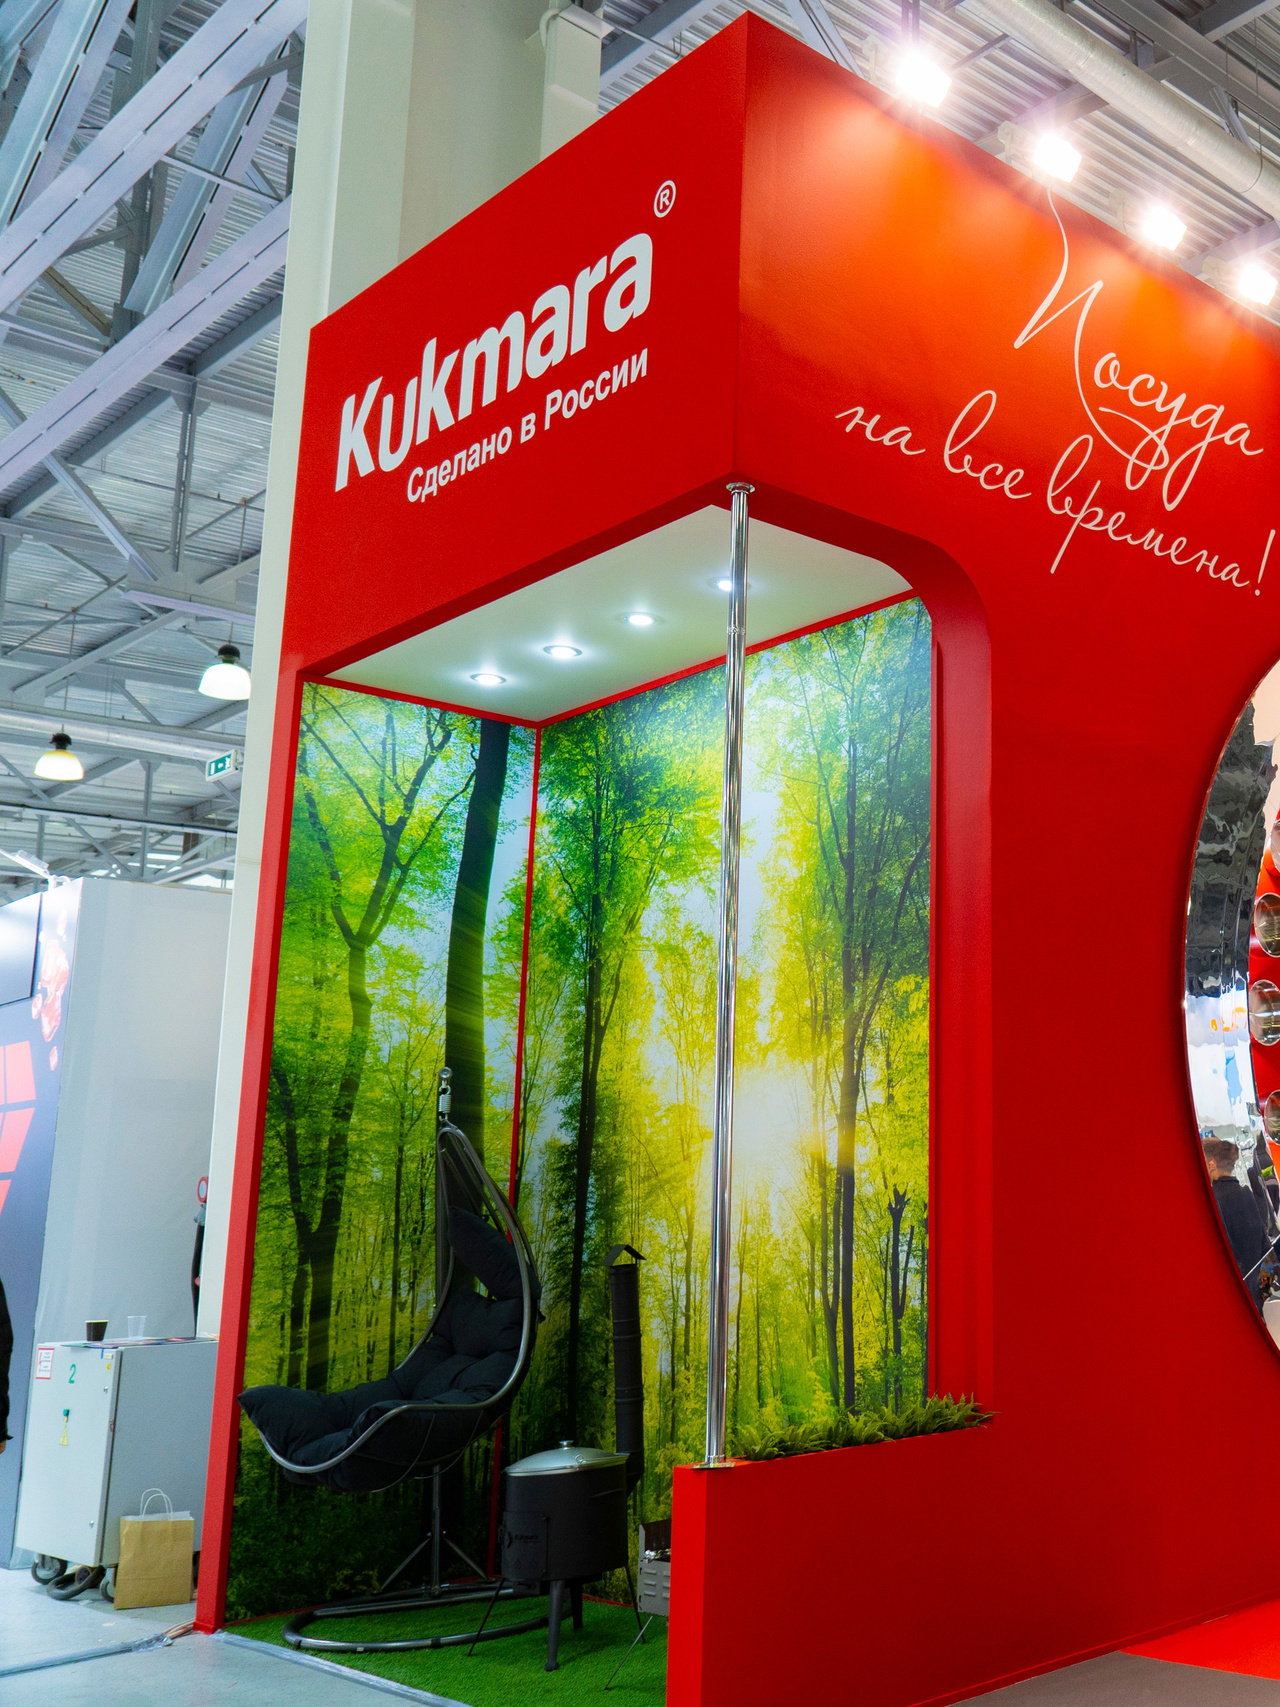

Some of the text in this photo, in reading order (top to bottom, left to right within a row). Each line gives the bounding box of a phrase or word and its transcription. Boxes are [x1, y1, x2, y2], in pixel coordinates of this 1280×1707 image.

[407, 347, 649, 503] Сделано в России
[835, 389, 1277, 597] на все времена!
[68, 1363, 77, 1384] 2
